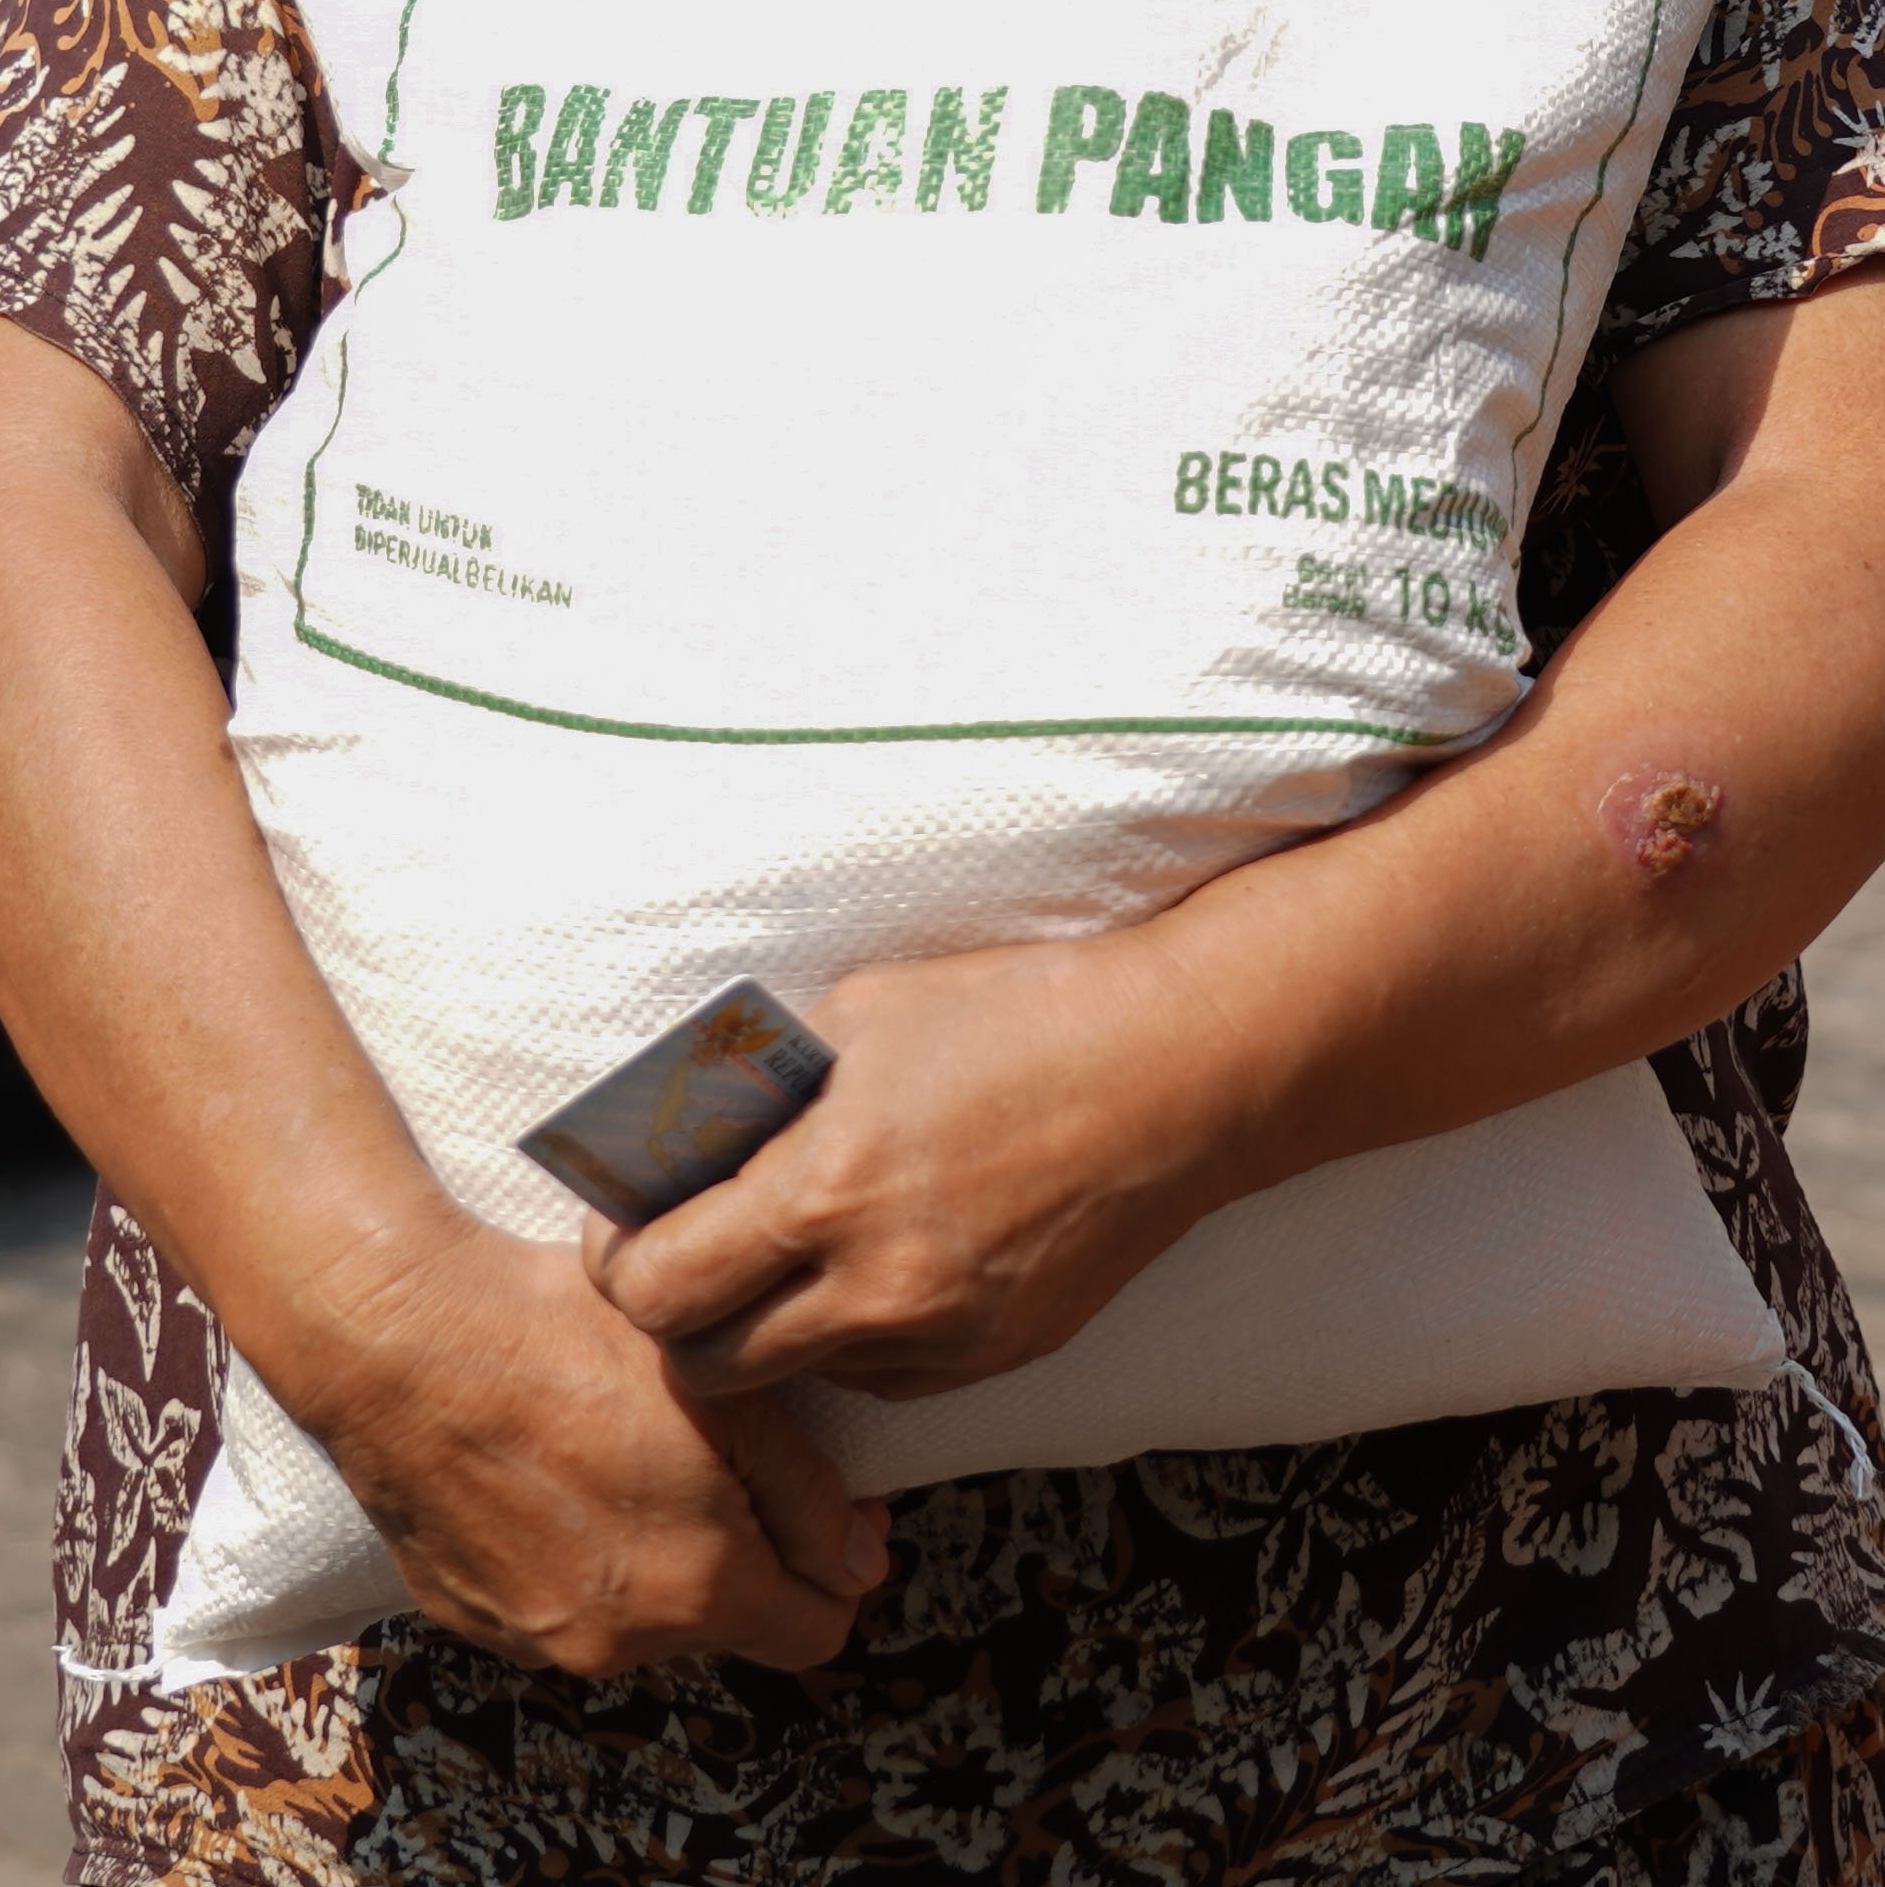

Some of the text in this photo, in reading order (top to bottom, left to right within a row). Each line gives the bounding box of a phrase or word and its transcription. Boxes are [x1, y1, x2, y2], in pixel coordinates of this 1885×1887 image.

[492, 82, 1009, 221] BANTUAN
[1036, 84, 1526, 263] PANGAN
[1174, 450, 1351, 522] BERAS
[354, 524, 573, 609] DIPERJUALBELIKAN
[1395, 566, 1451, 628] 10
